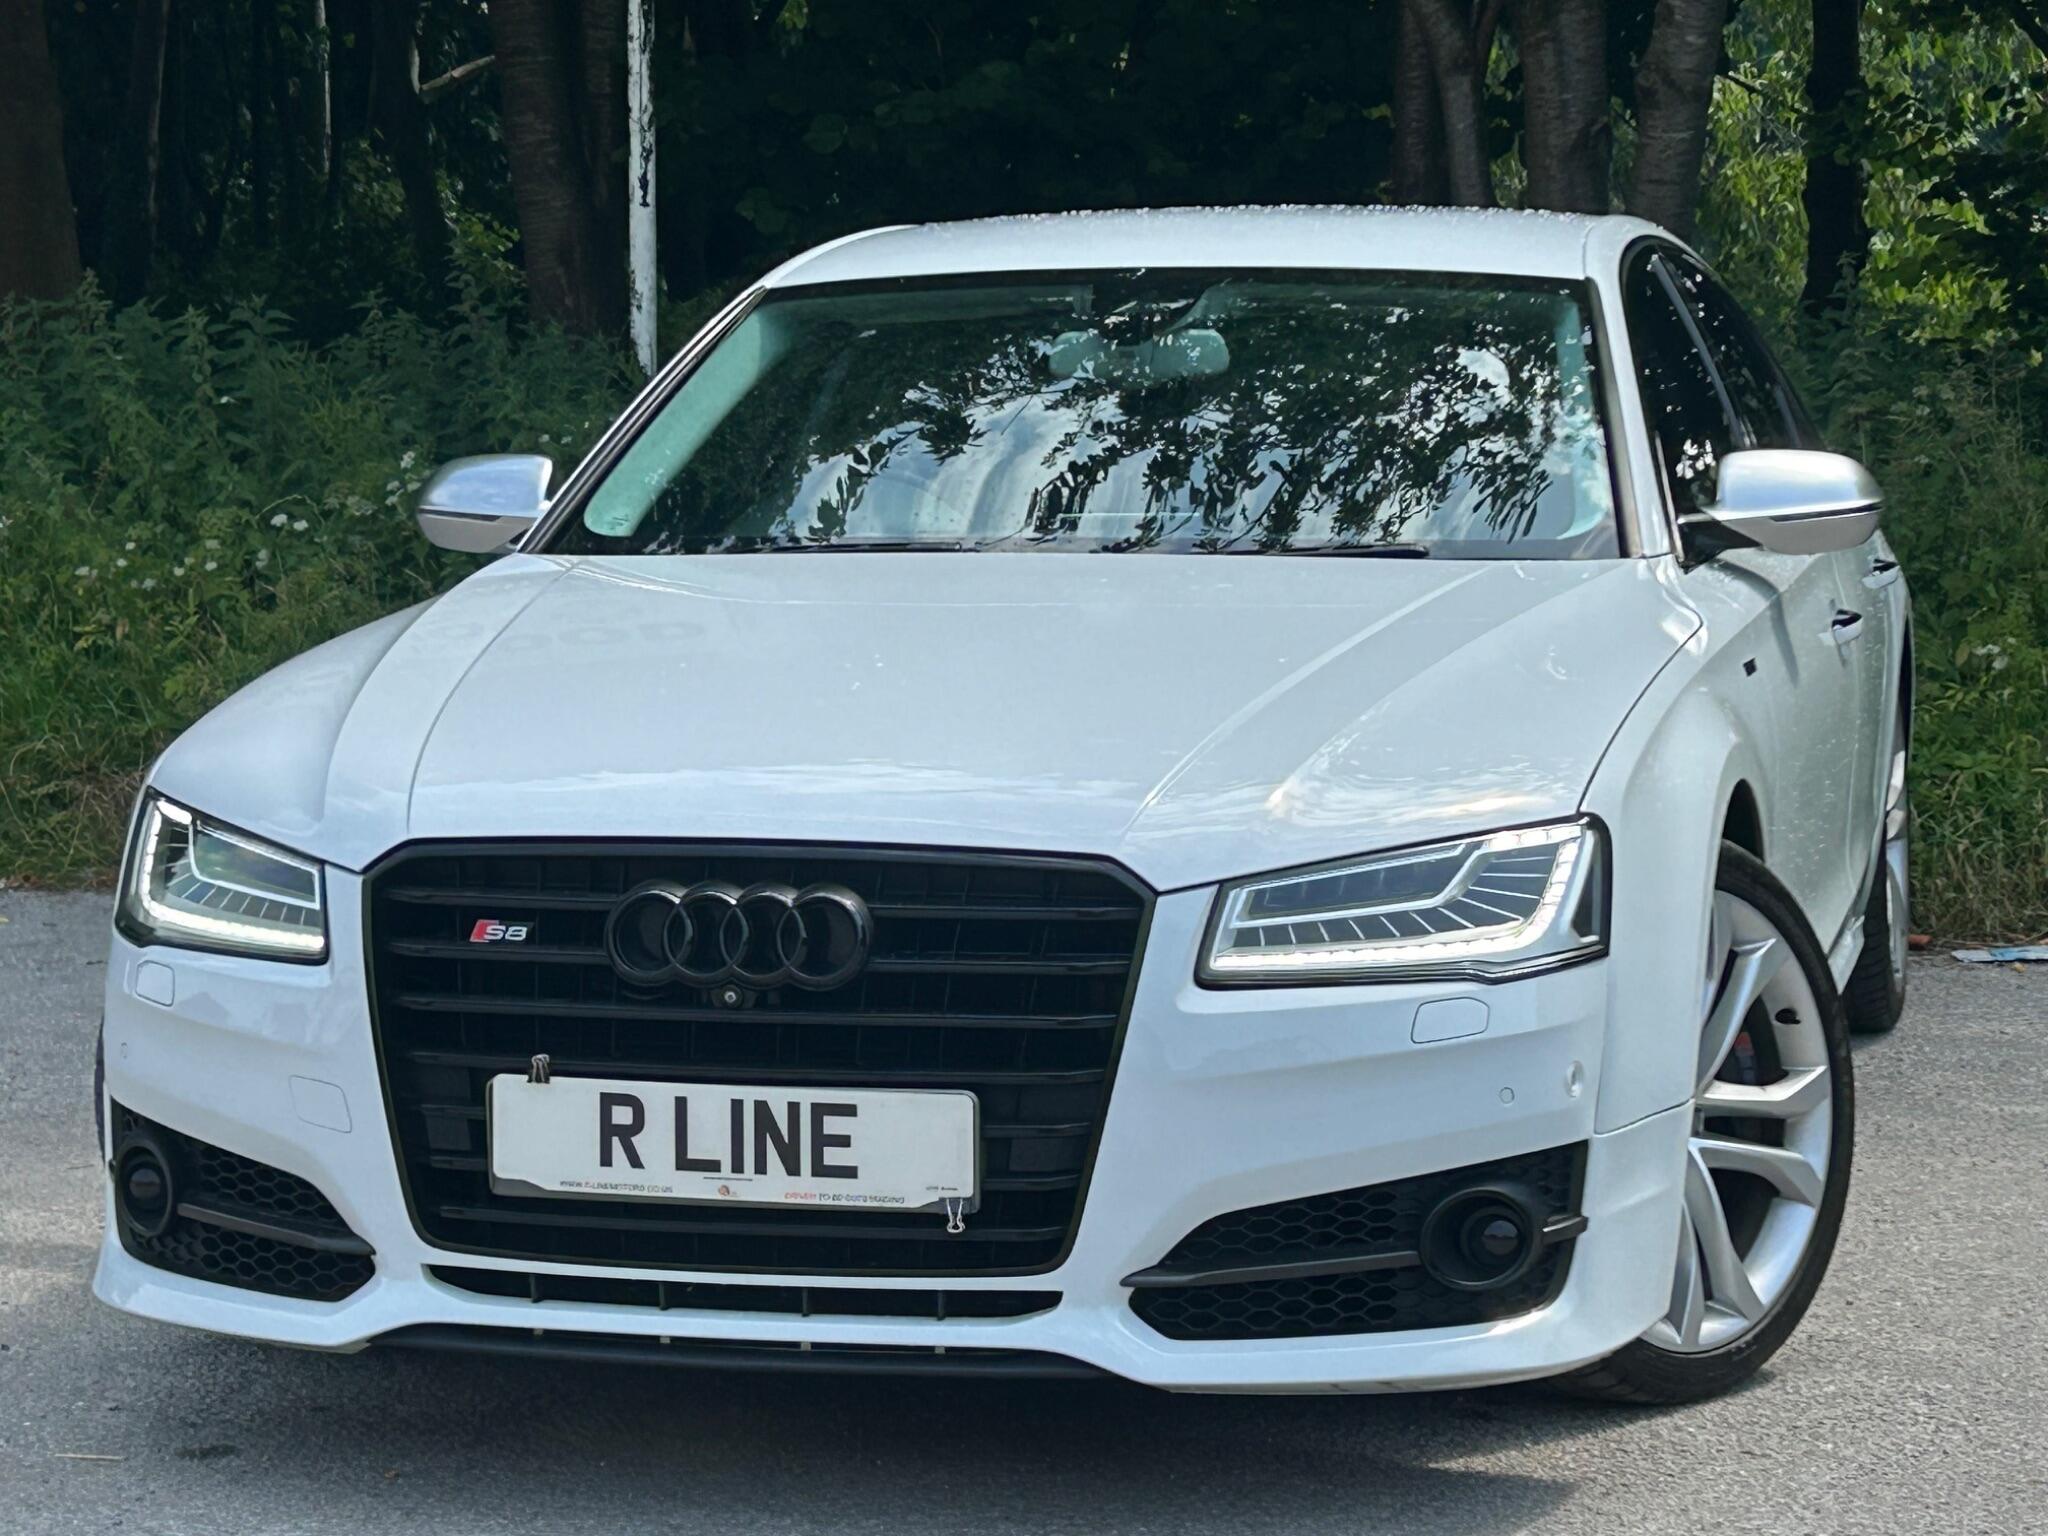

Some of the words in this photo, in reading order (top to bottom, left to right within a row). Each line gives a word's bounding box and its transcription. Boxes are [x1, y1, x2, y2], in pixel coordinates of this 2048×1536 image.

[484, 925, 528, 941] S8
[599, 1091, 646, 1170] R
[675, 1096, 859, 1180] LINE
